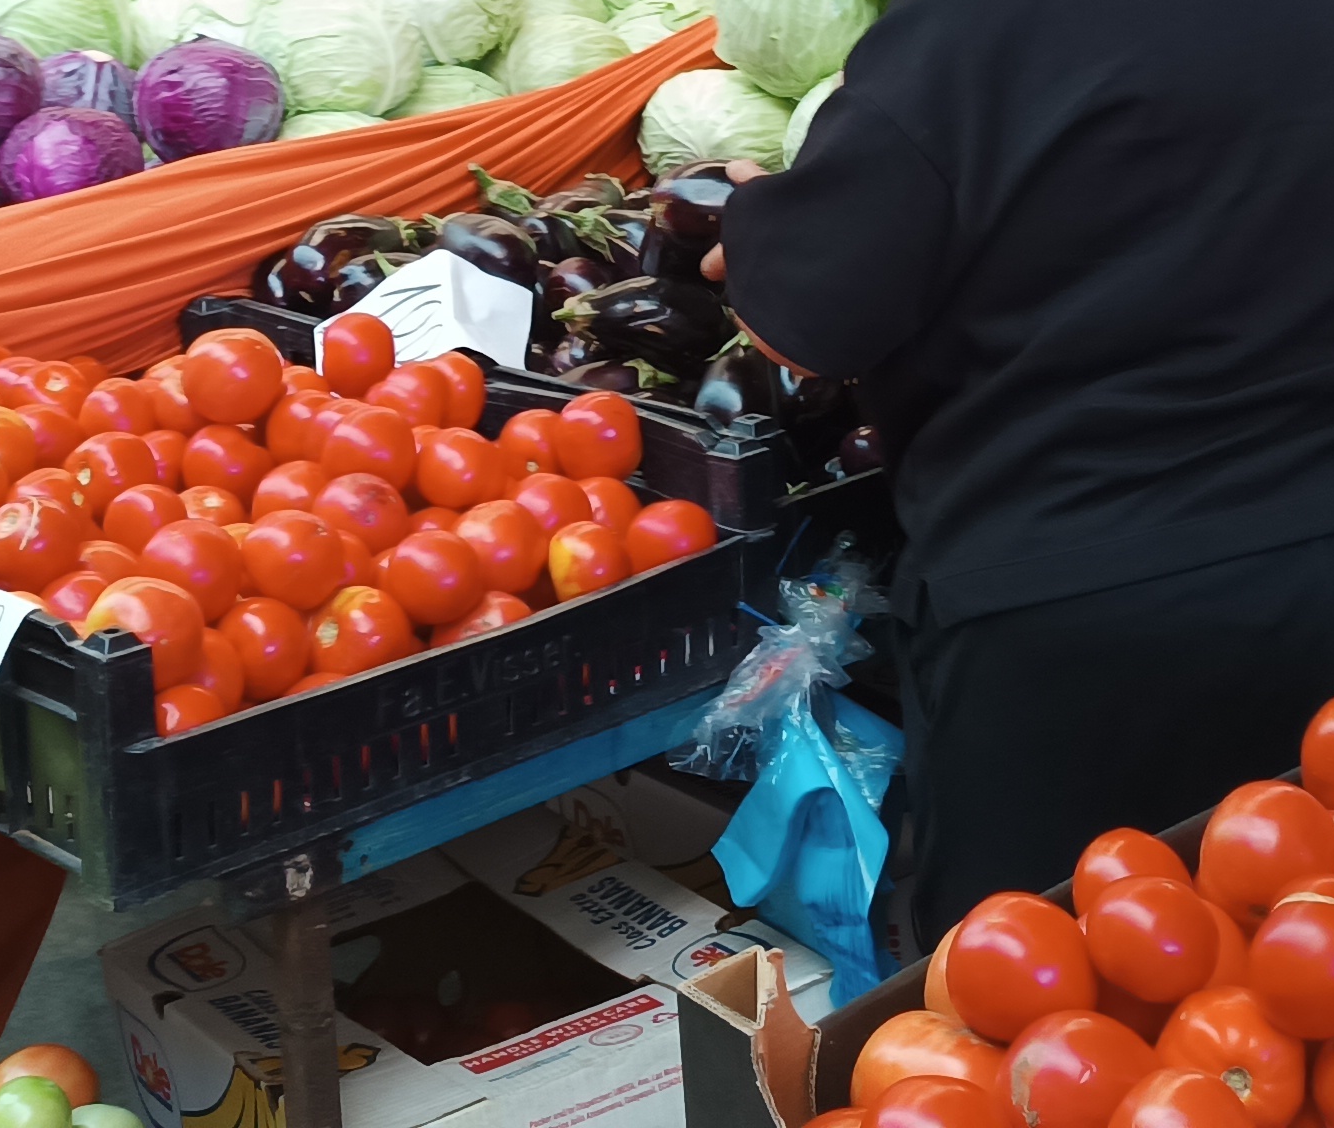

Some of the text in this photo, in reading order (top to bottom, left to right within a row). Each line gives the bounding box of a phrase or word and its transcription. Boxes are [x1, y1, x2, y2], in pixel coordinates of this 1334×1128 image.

[569, 892, 657, 951] Class Extra
[587, 875, 689, 939] BANANAS
[464, 1037, 543, 1069] HANDLE
[544, 1015, 599, 1039] WITH
[602, 996, 651, 1018] CARE
